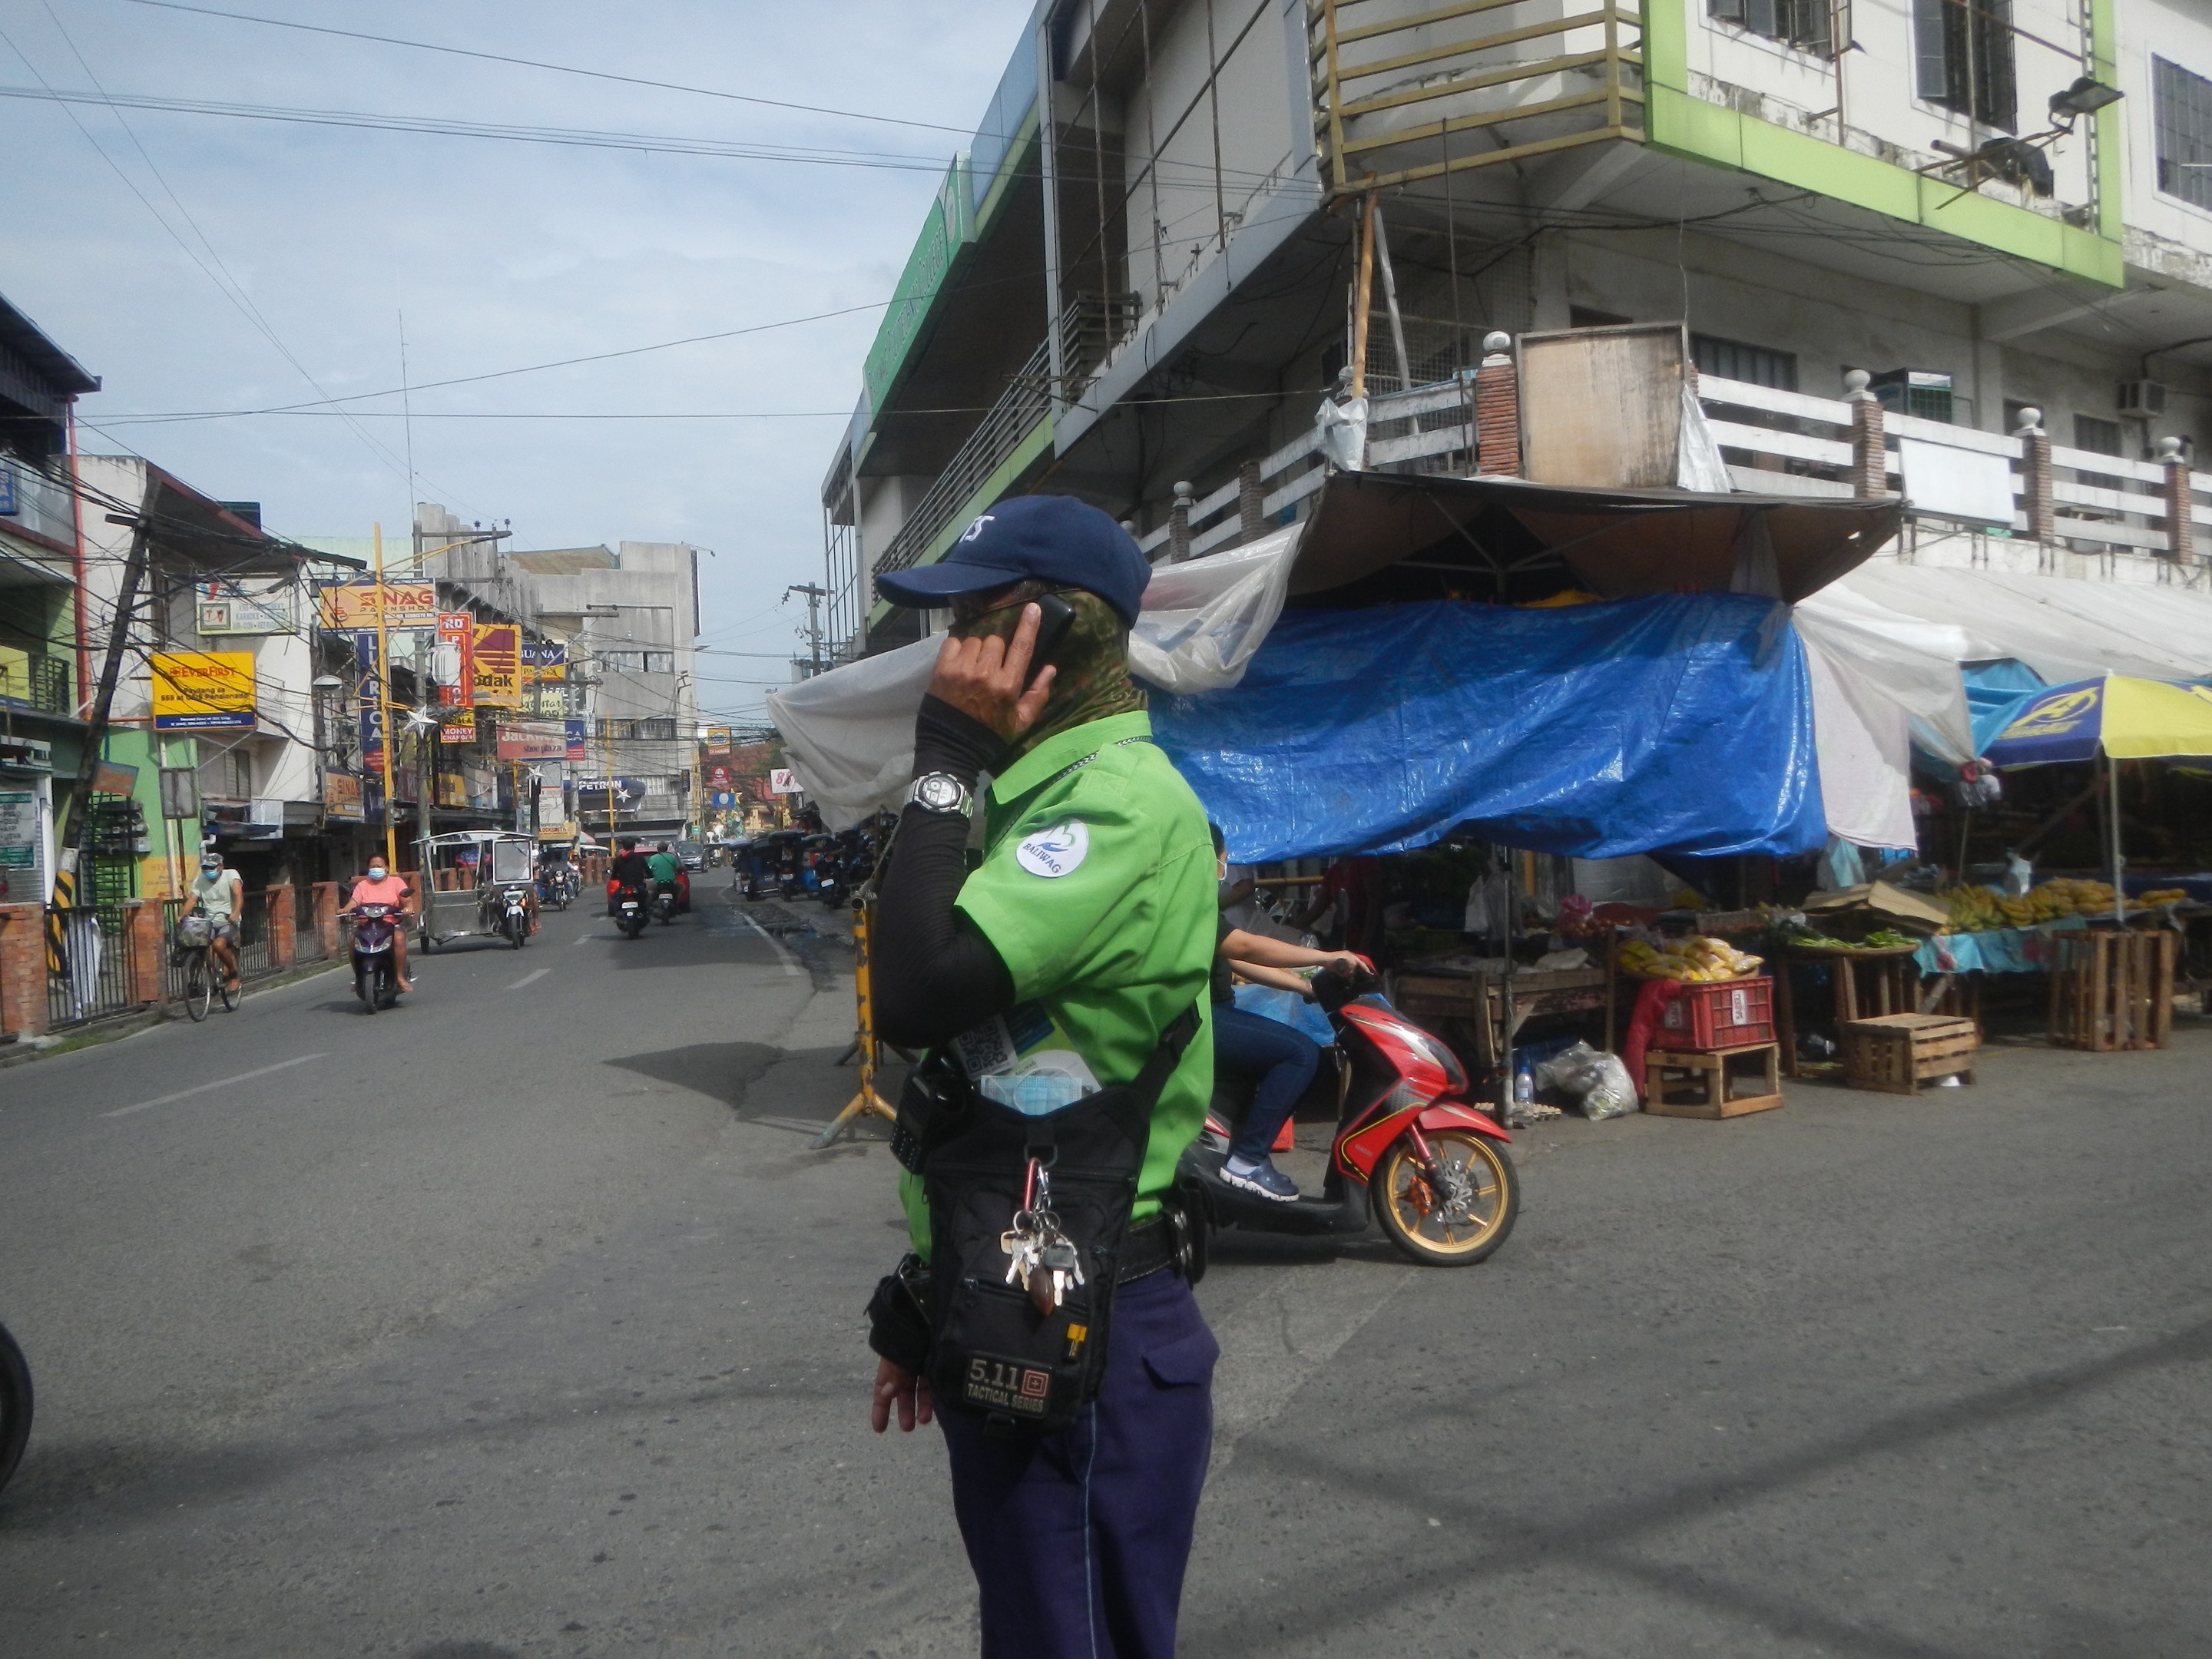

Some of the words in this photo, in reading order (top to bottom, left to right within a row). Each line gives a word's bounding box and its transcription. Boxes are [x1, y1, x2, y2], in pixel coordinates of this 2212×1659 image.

[359, 591, 434, 606] SNAG
[445, 618, 464, 629] RD
[474, 674, 513, 687] odak
[578, 780, 623, 790] PETRON
[1022, 843, 1061, 874] BALIWAG
[970, 1358, 1018, 1391] 5.11
[968, 1382, 1009, 1407] TACTICAL
[1010, 1394, 1045, 1413] SERIES
